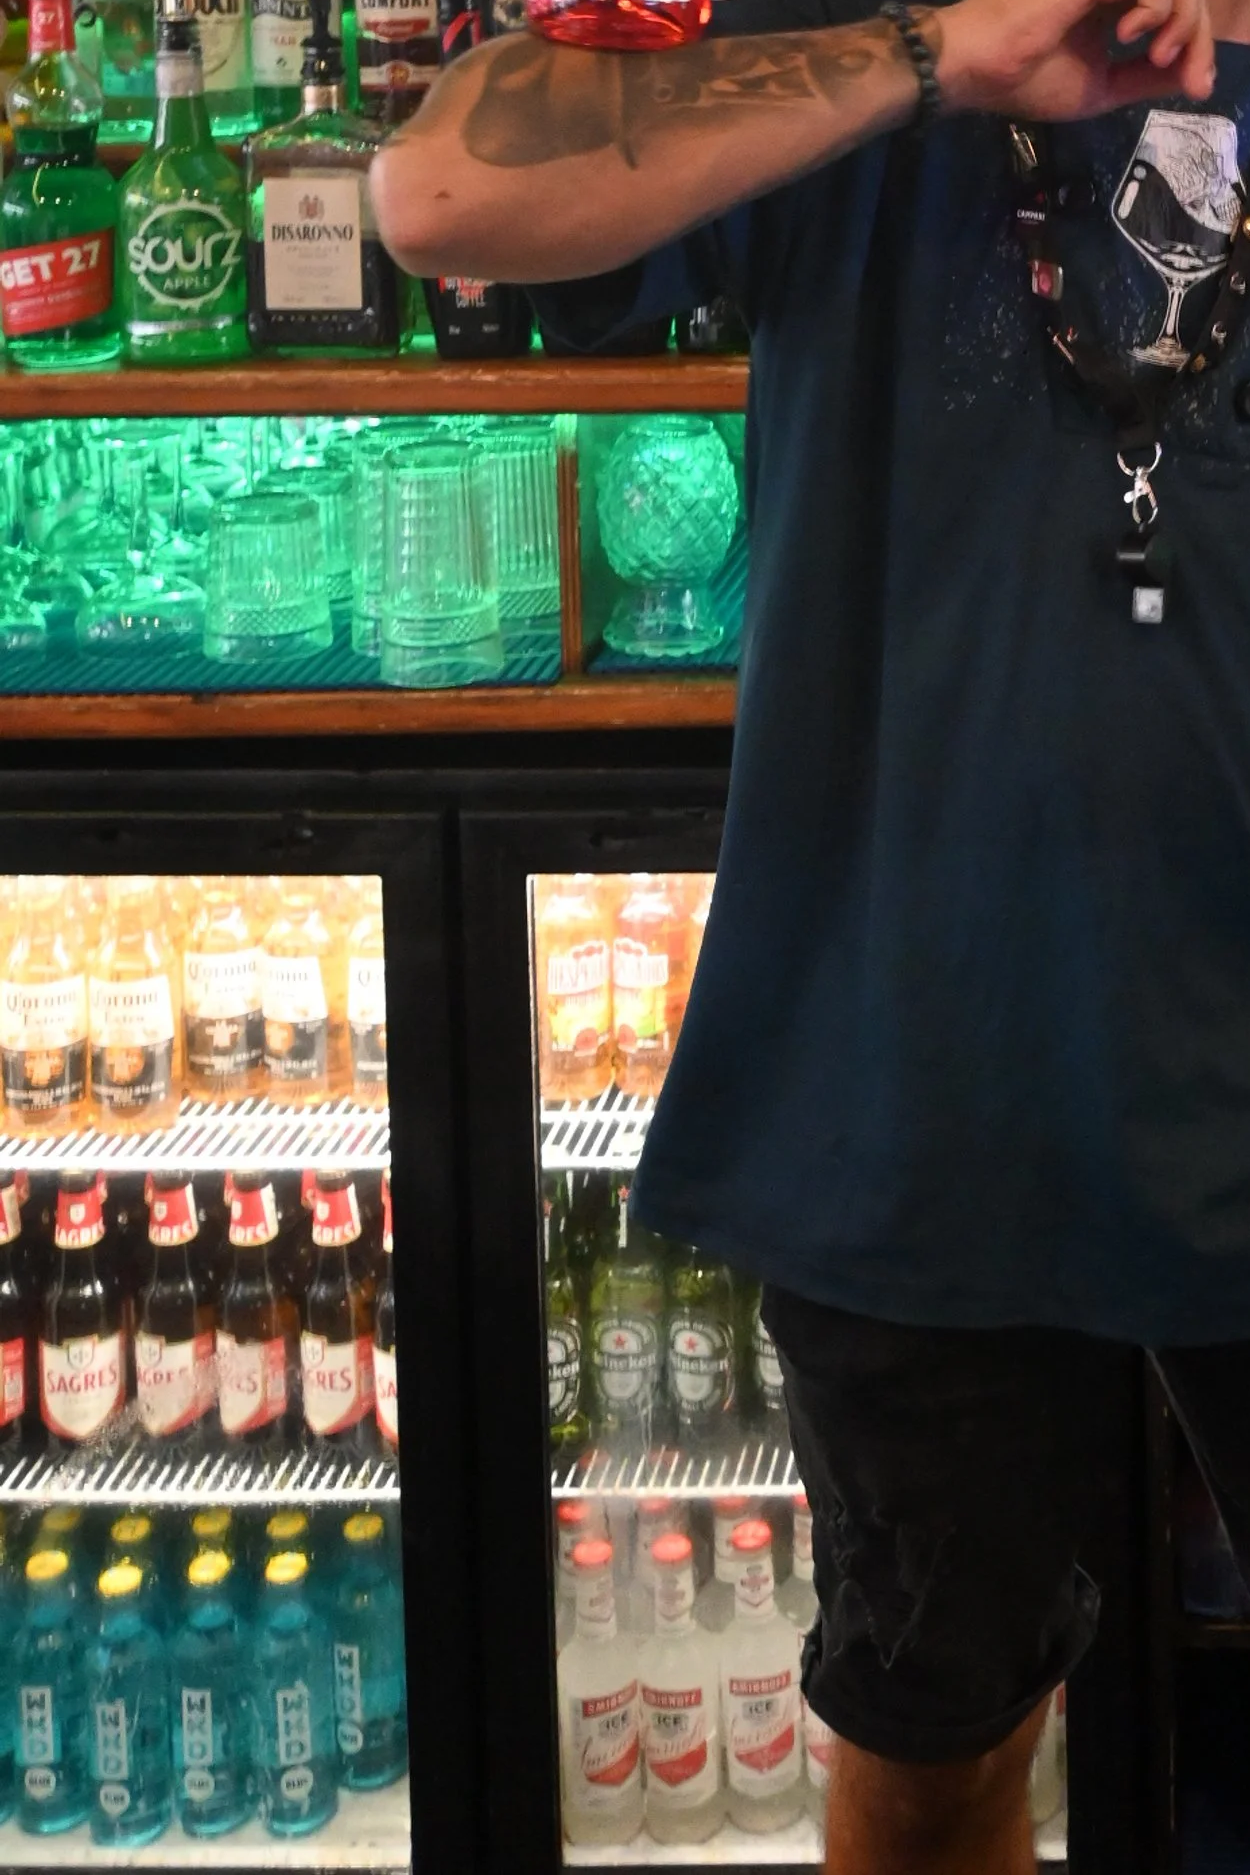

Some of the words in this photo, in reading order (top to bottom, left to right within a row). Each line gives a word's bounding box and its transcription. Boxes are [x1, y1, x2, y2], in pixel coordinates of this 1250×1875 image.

[271, 223, 354, 242] DISARONNO
[0, 252, 55, 289] GET
[62, 239, 101, 275] 27
[163, 276, 210, 291] APPLE
[150, 1223, 194, 1244] GRES
[47, 1363, 117, 1393] SAGRES
